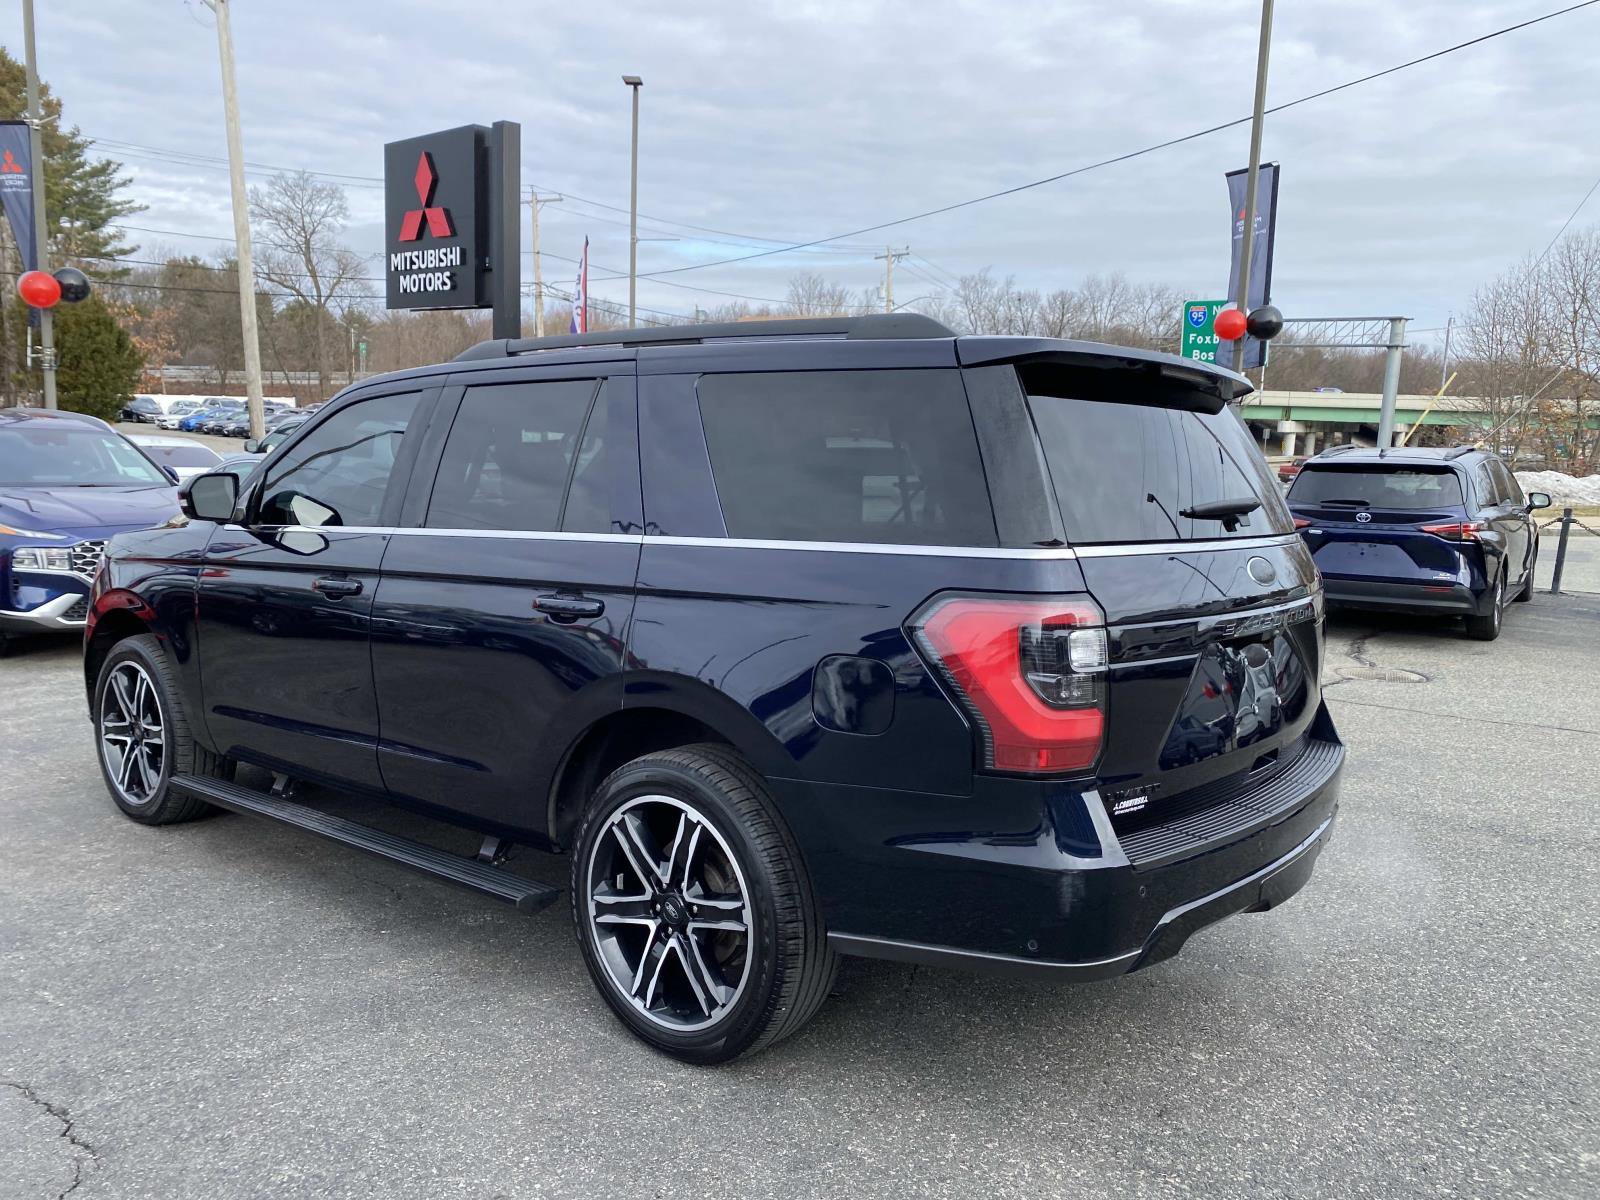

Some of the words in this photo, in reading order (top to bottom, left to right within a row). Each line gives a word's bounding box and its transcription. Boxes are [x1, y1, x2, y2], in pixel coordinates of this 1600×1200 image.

[391, 246, 460, 271] MITSUBISHI
[399, 271, 451, 293] MOTORS
[1192, 311, 1204, 322] 95
[1192, 349, 1214, 361] Bos
